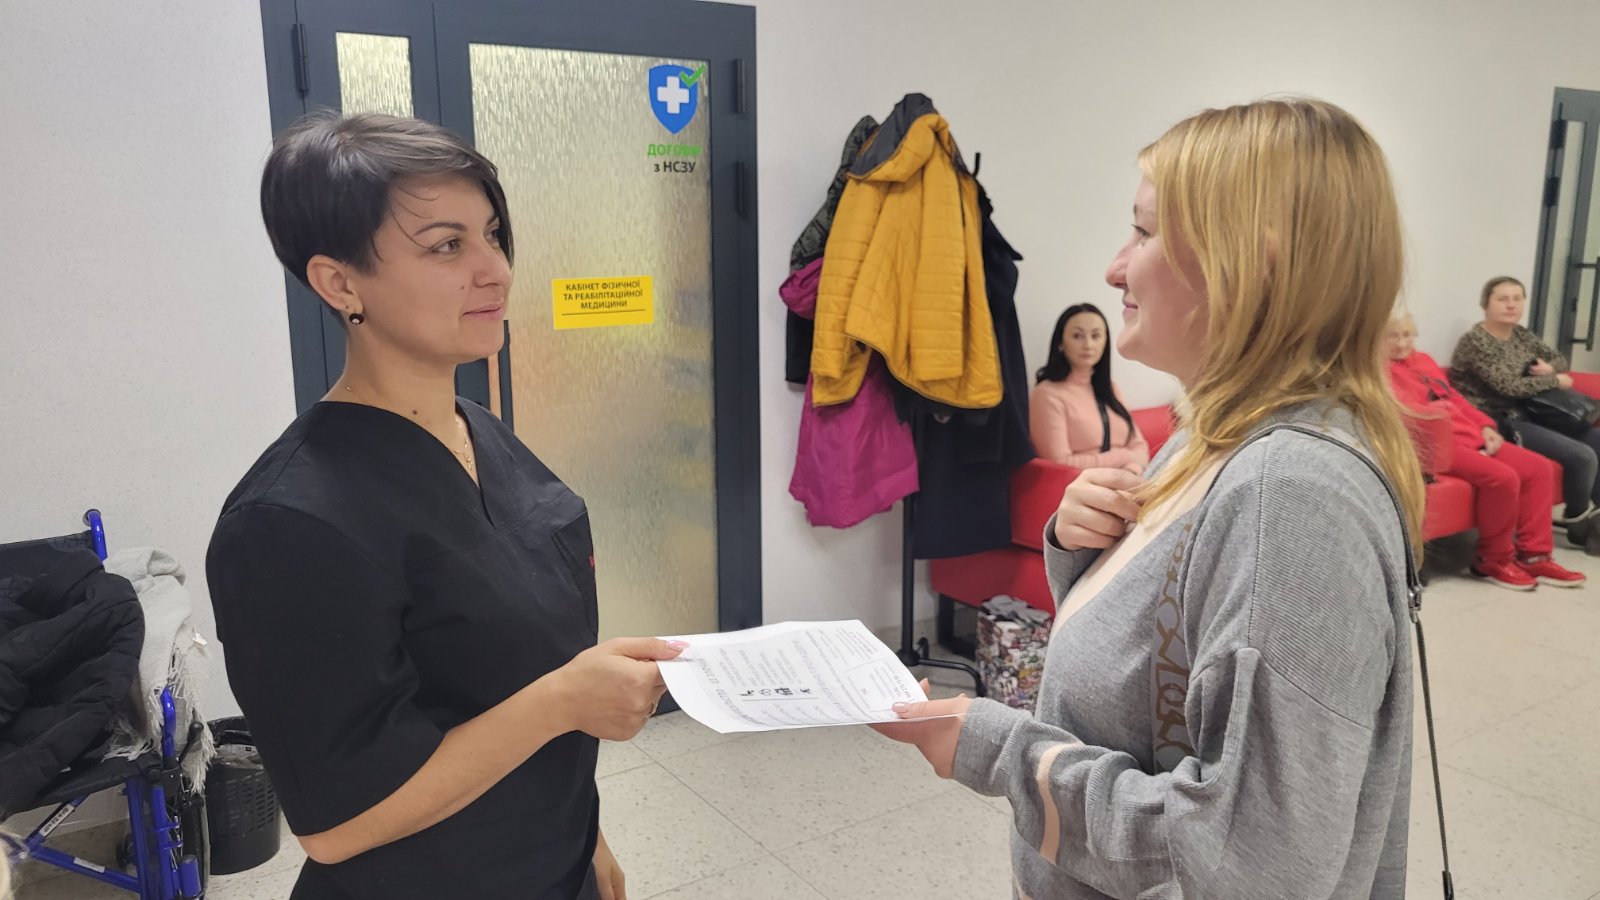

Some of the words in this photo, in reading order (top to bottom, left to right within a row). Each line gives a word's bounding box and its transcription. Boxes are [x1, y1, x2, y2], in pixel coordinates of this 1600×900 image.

[663, 161, 696, 173] НСЗУ
[566, 283, 599, 291] КАБІНЕТ
[601, 280, 640, 290] ФІЗИЧНОЇ
[575, 290, 643, 300] РЕАБІЛІТАЦІЙНОЇ
[580, 301, 627, 310] МЕДИЦИНИ
